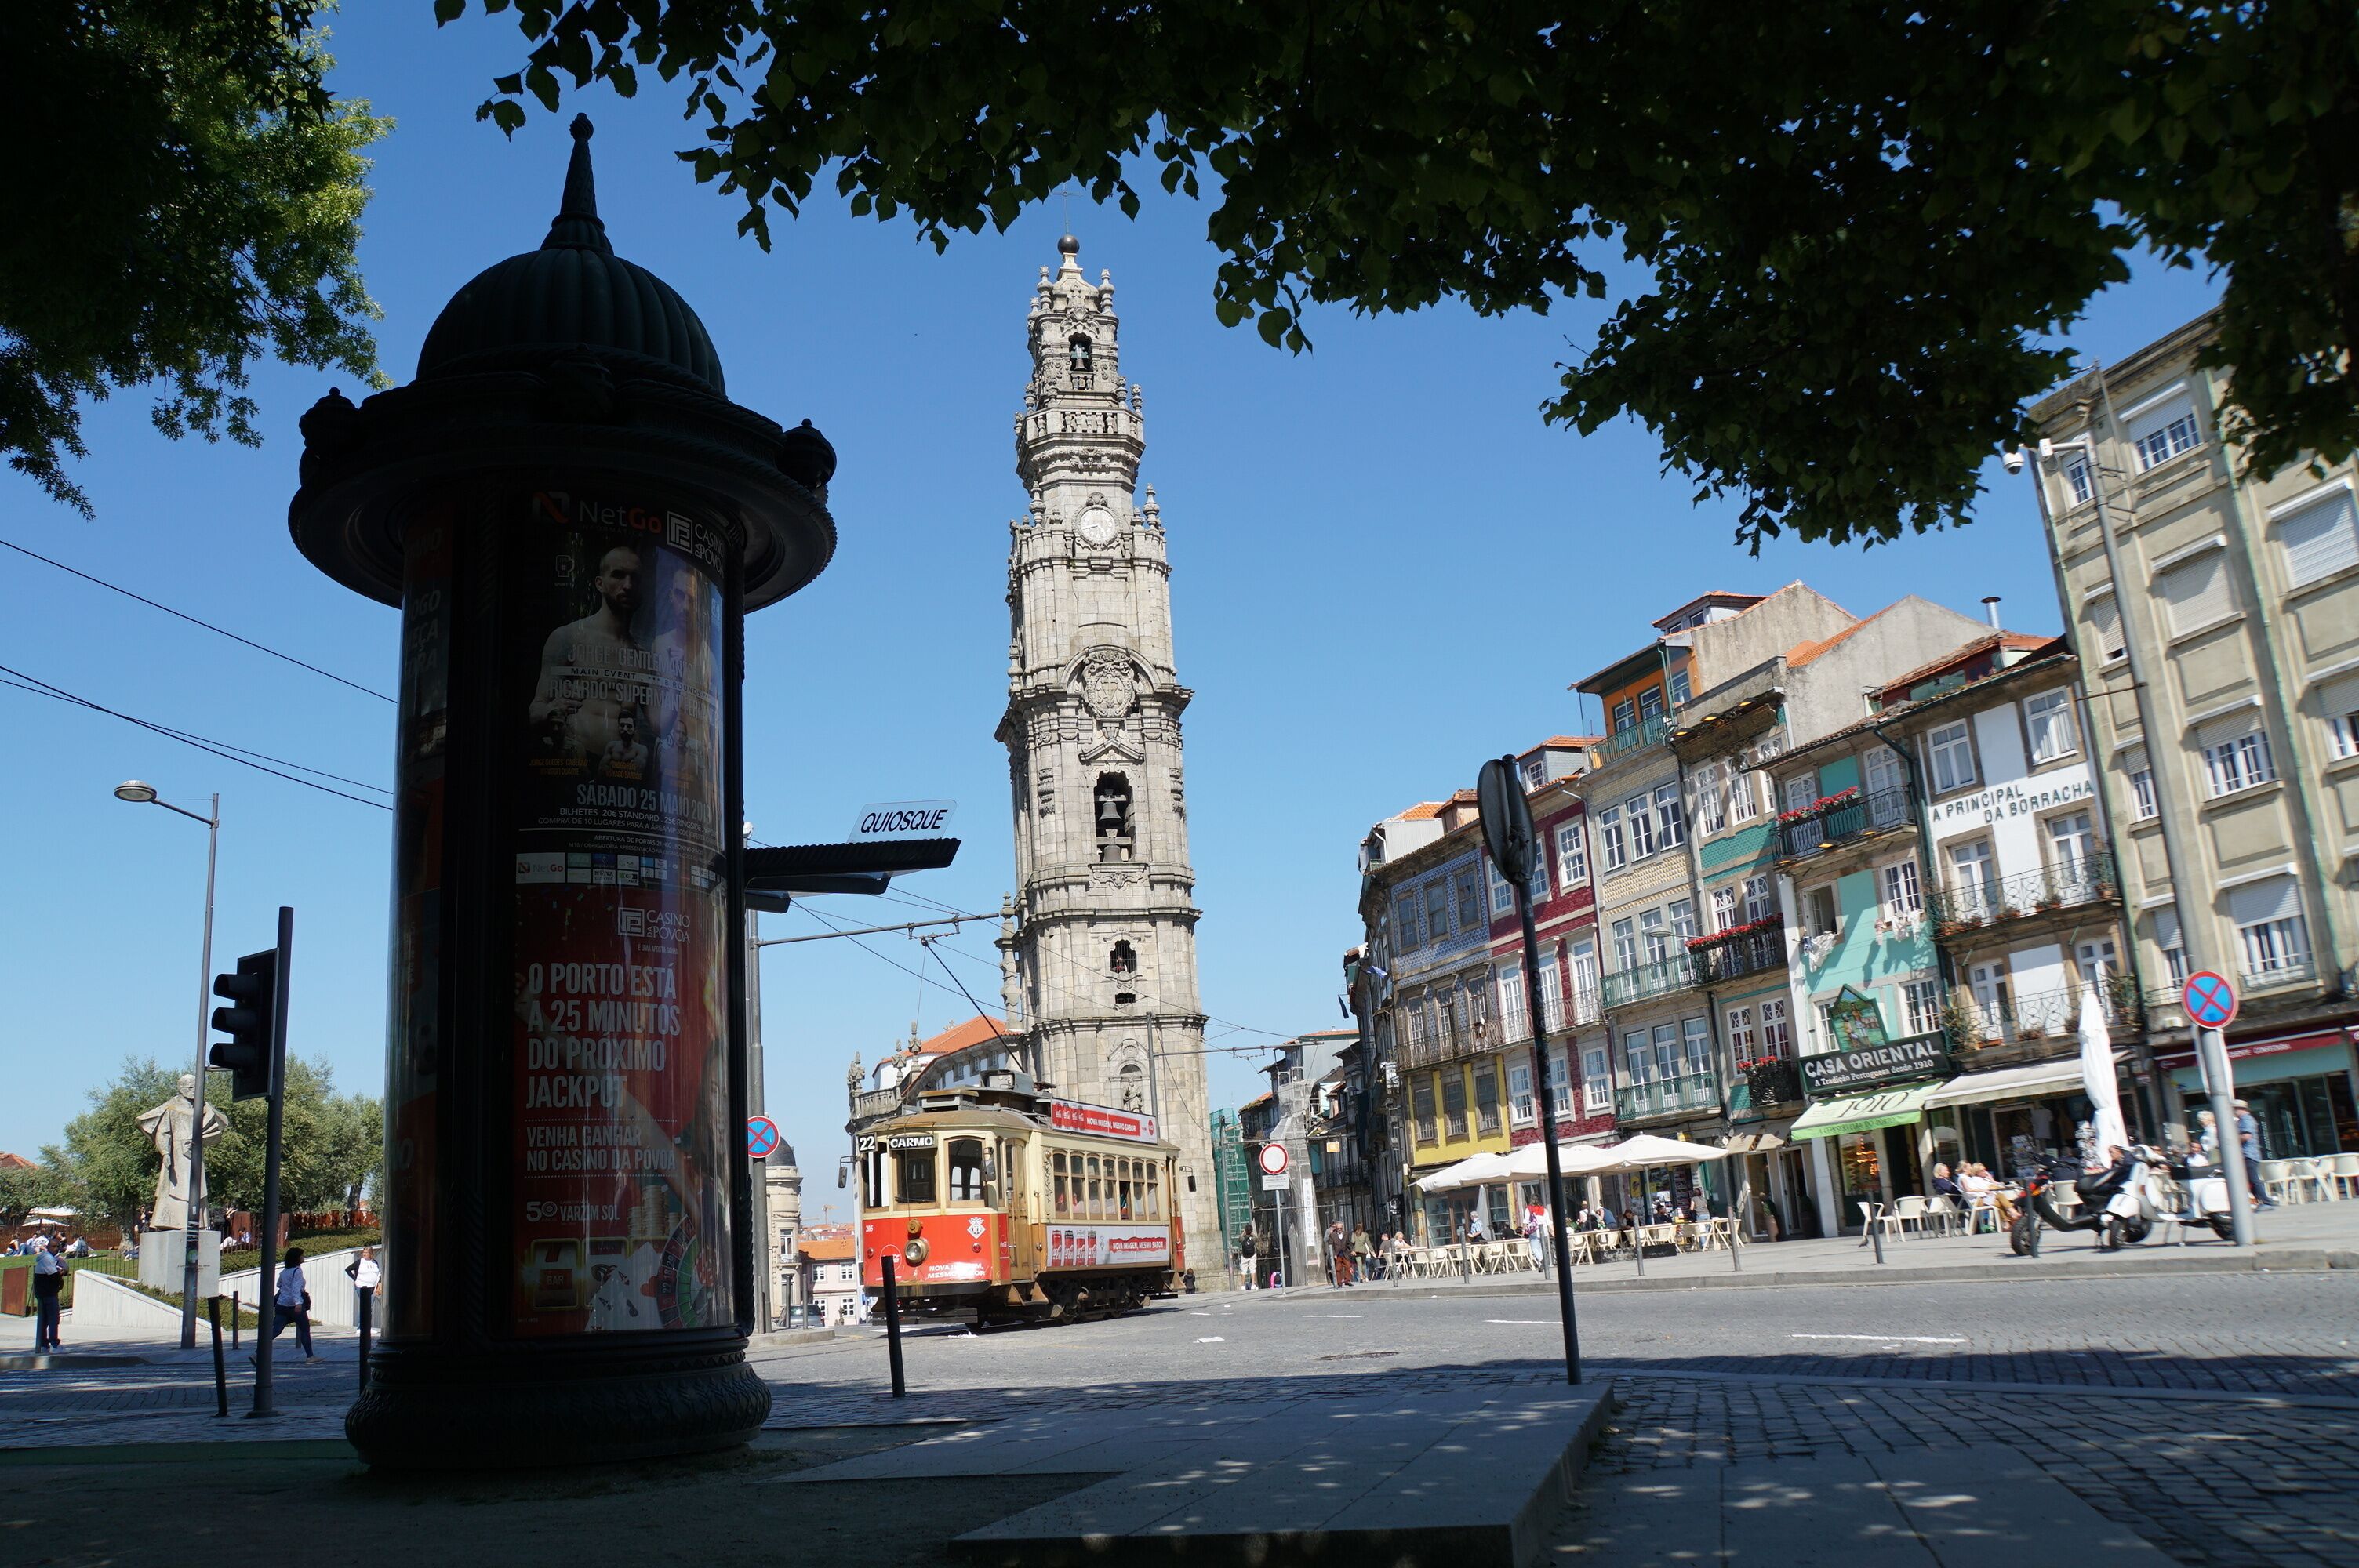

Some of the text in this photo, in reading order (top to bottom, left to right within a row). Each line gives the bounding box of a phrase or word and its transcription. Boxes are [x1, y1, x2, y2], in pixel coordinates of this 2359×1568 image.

[578, 501, 663, 535] NetGo
[567, 644, 609, 665] JORGE
[549, 679, 608, 700] RICARDO
[604, 670, 636, 680] EVENT
[672, 682, 701, 697] ROUNDS
[576, 780, 637, 808] SÁBADO
[640, 788, 657, 811] 25
[660, 792, 689, 818] MAIO
[1933, 785, 2024, 822] A PRINCIPAL
[1984, 780, 2094, 822] DA BORRACHA
[559, 808, 598, 817] BILHETES
[602, 809, 617, 818] 20€
[618, 811, 660, 822] STANDARD
[664, 816, 676, 826] 25€
[677, 818, 702, 833] RINGSIDE
[594, 818, 625, 827] LUGARES
[860, 809, 948, 833] QUIOSQUE
[594, 834, 625, 843] ABERTURA
[635, 837, 656, 846] PORTAS
[532, 863, 564, 873] NetGo
[646, 909, 690, 928] CASINO
[646, 924, 691, 943] DA PÓVOA
[529, 962, 677, 999] O PORTO ESTÁ
[528, 1000, 681, 1036] A 25 MINUTOS
[528, 1031, 666, 1072] DO PRÓXIMO
[1805, 1040, 1941, 1078] CASA ORIENTAL
[1820, 1074, 1851, 1086] Tradição
[1852, 1069, 1890, 1081] Portuguesa
[1891, 1064, 1913, 1073] desde
[1914, 1059, 1934, 1069] 1910
[526, 1076, 628, 1109] JACKPOT
[1838, 1092, 1909, 1118] 1910
[527, 1126, 641, 1147] VENHA GANHAR
[859, 1136, 875, 1151] 22
[890, 1136, 933, 1149] CARMO
[527, 1147, 676, 1171] NO CASINO DA PÓVOA
[559, 1204, 598, 1221] VARZIM
[601, 1203, 620, 1221] SOL
[547, 1276, 564, 1286] BAR
